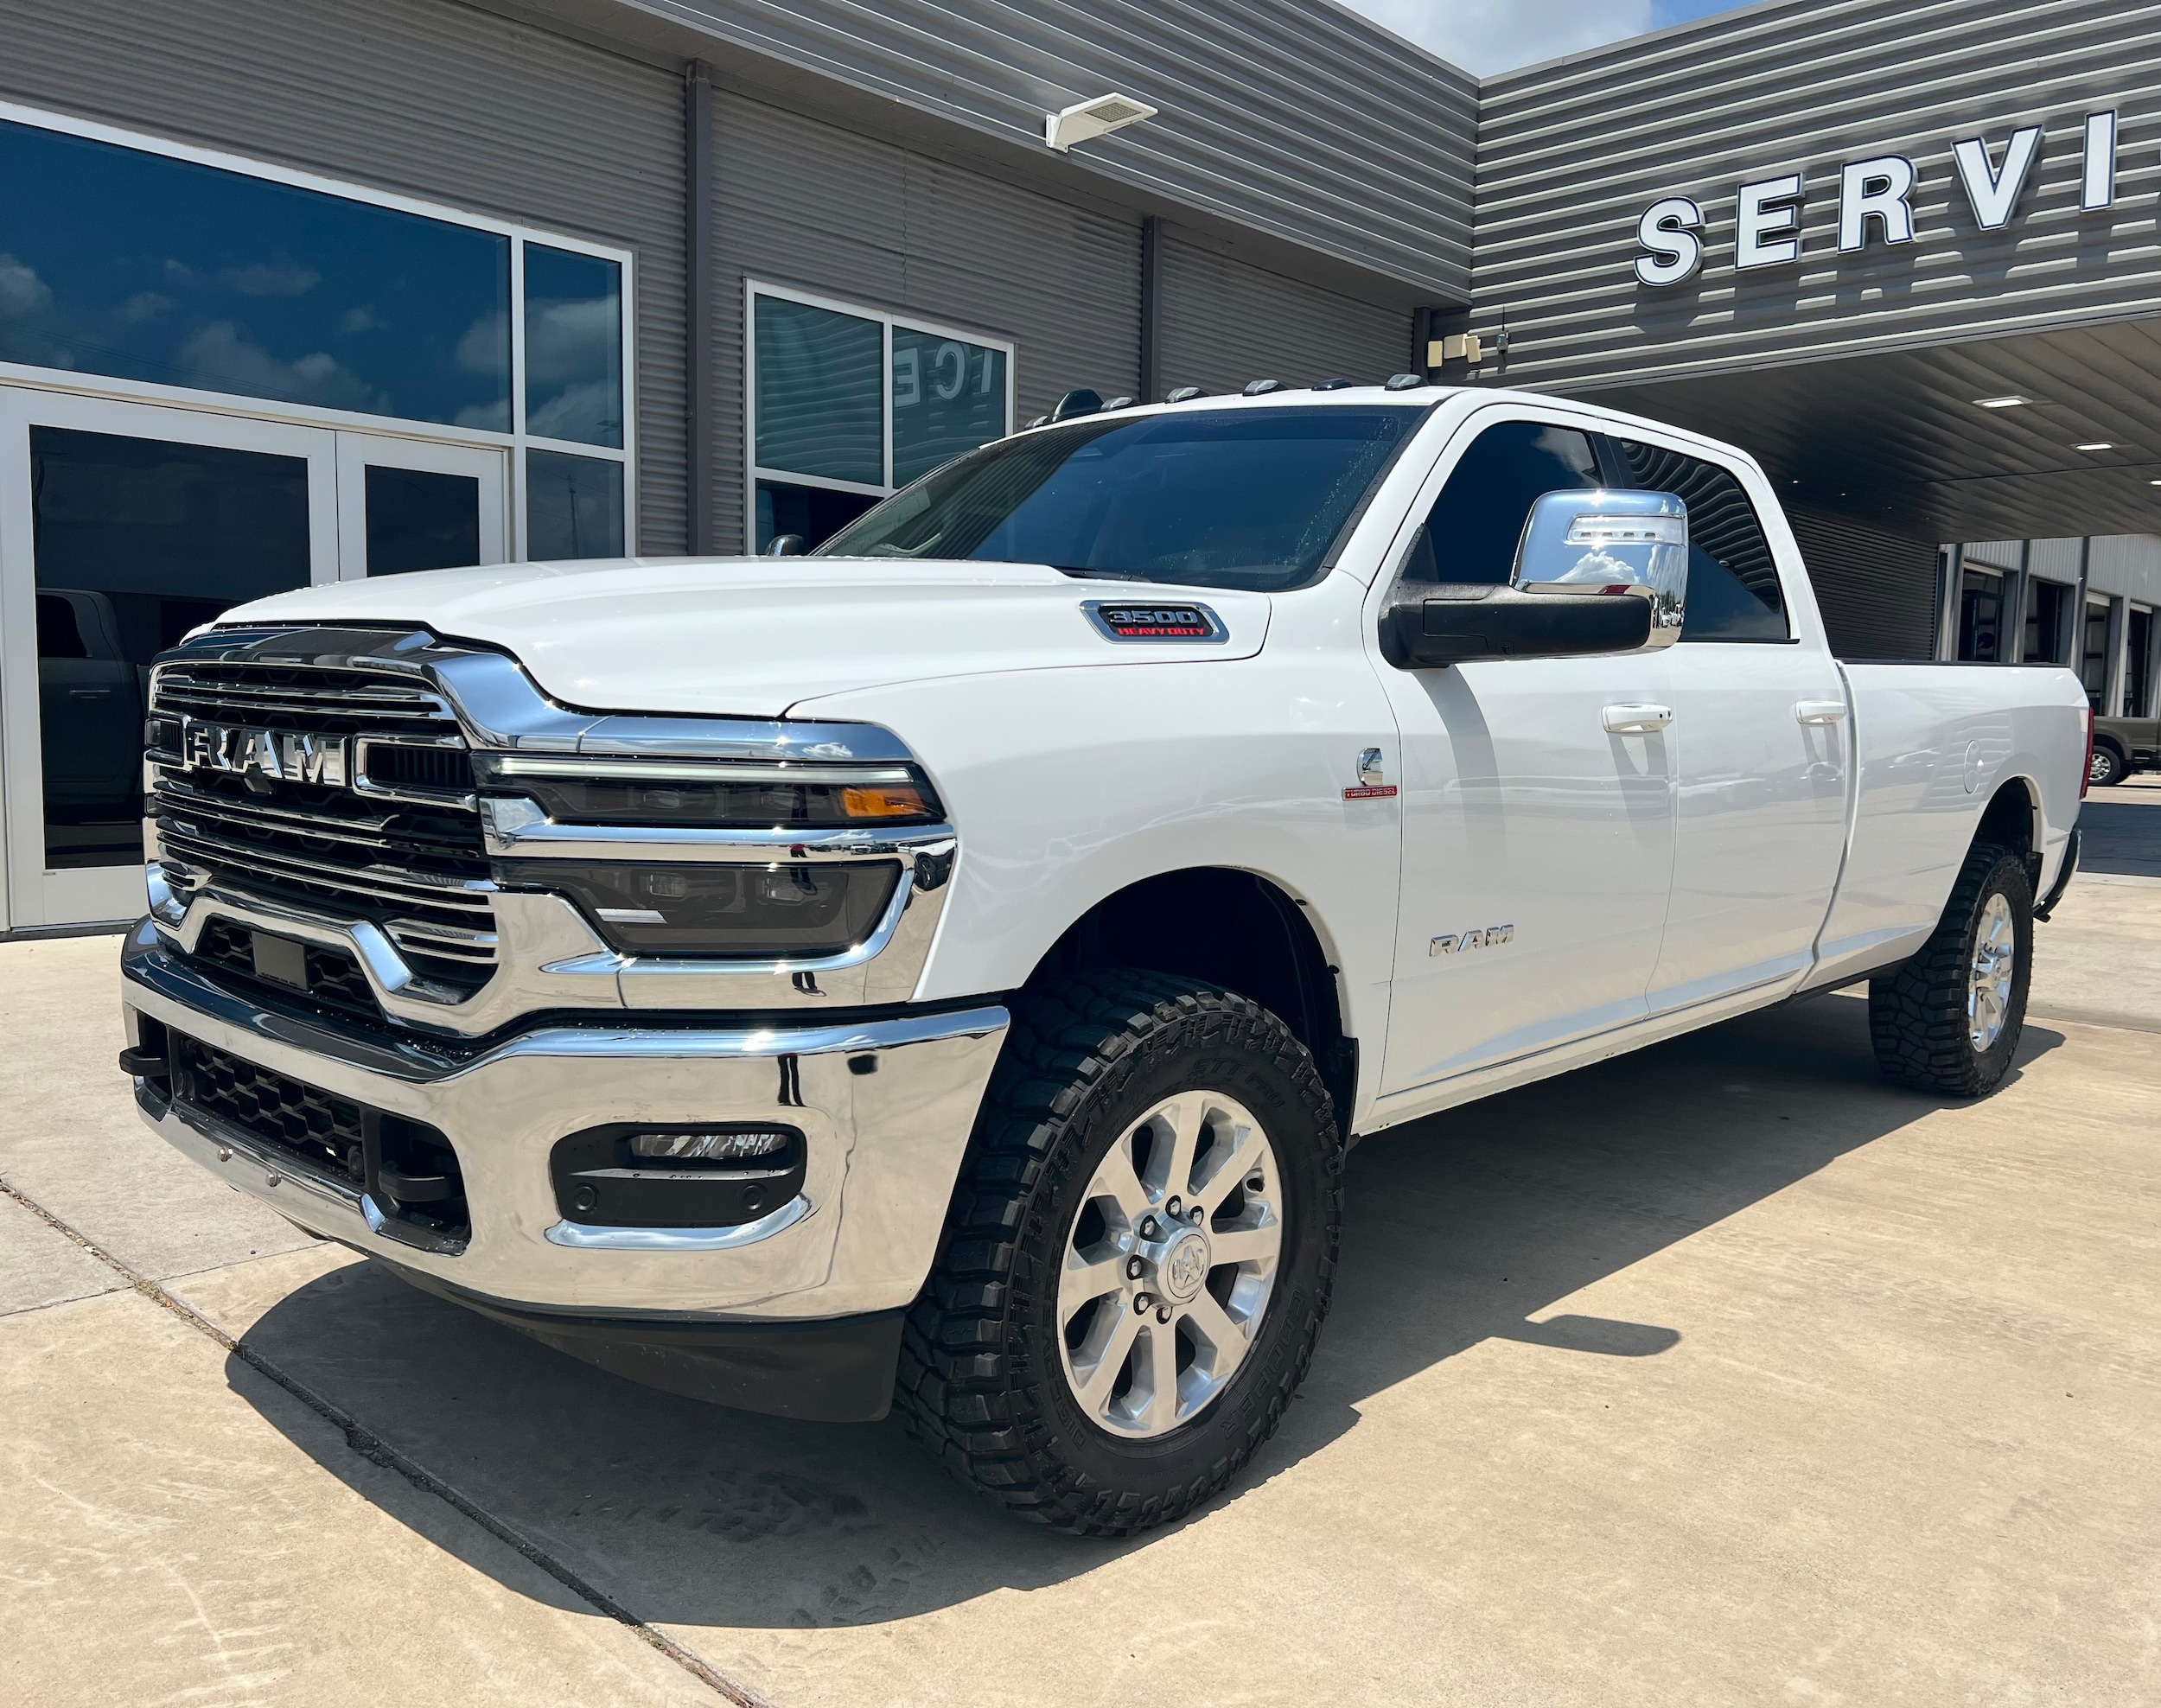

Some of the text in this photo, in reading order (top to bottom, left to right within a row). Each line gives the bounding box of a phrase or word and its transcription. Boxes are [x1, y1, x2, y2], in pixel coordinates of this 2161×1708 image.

[1634, 107, 2119, 288] SERVI
[1107, 610, 1199, 624] 3500
[186, 726, 347, 787] RAM
[1345, 787, 1397, 797] TURBO DIESEL
[1429, 924, 1514, 957] RAM
[1220, 1286, 1306, 1440] COOPER
